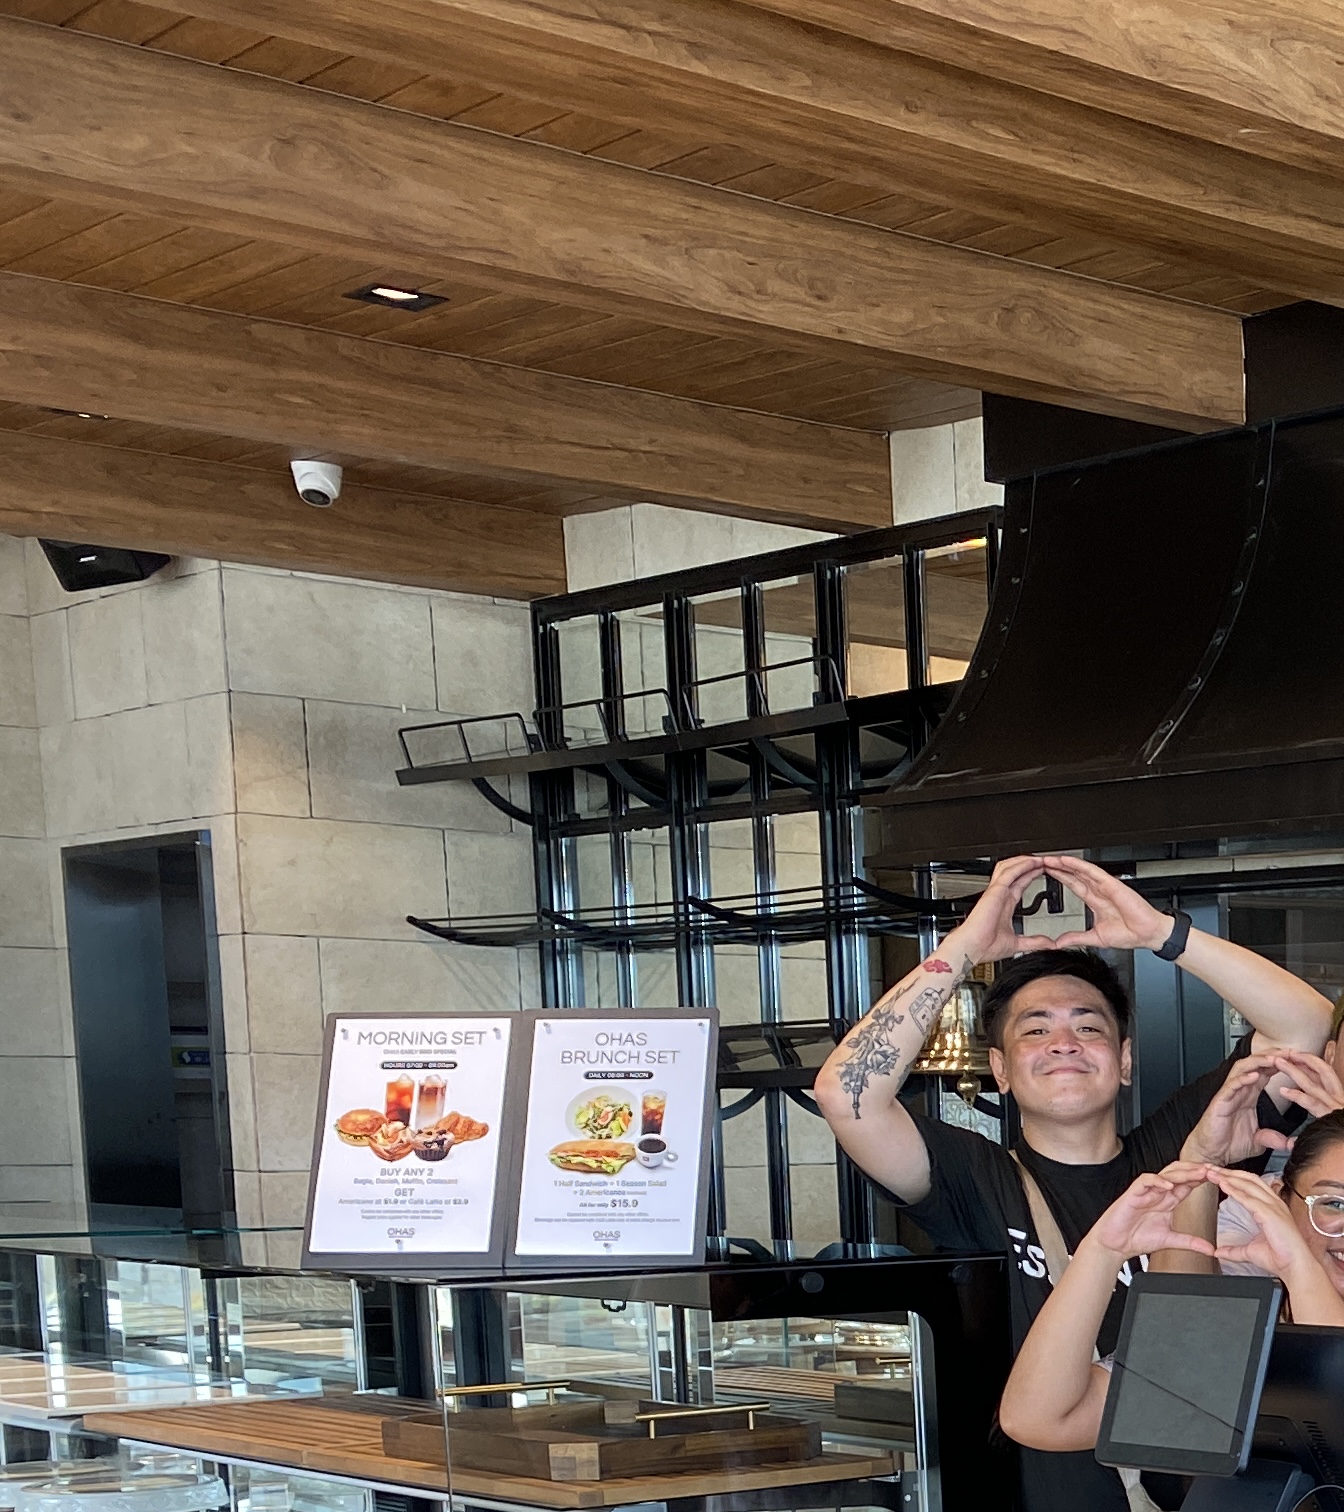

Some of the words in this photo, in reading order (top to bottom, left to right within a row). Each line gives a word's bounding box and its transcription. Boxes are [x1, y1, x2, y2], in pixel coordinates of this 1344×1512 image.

[356, 1030, 447, 1045] MORNING
[450, 1030, 487, 1045] SET
[594, 1032, 647, 1046] OHAS
[560, 1049, 640, 1064] BRUNCH
[644, 1050, 680, 1064] SET
[379, 1167, 401, 1176] BUY
[402, 1167, 425, 1176] ANY
[426, 1167, 433, 1176] 2
[574, 1179, 608, 1187] Sandwich
[393, 1187, 414, 1196] GET
[386, 1227, 415, 1236] OHAS
[592, 1230, 620, 1239] OHAS
